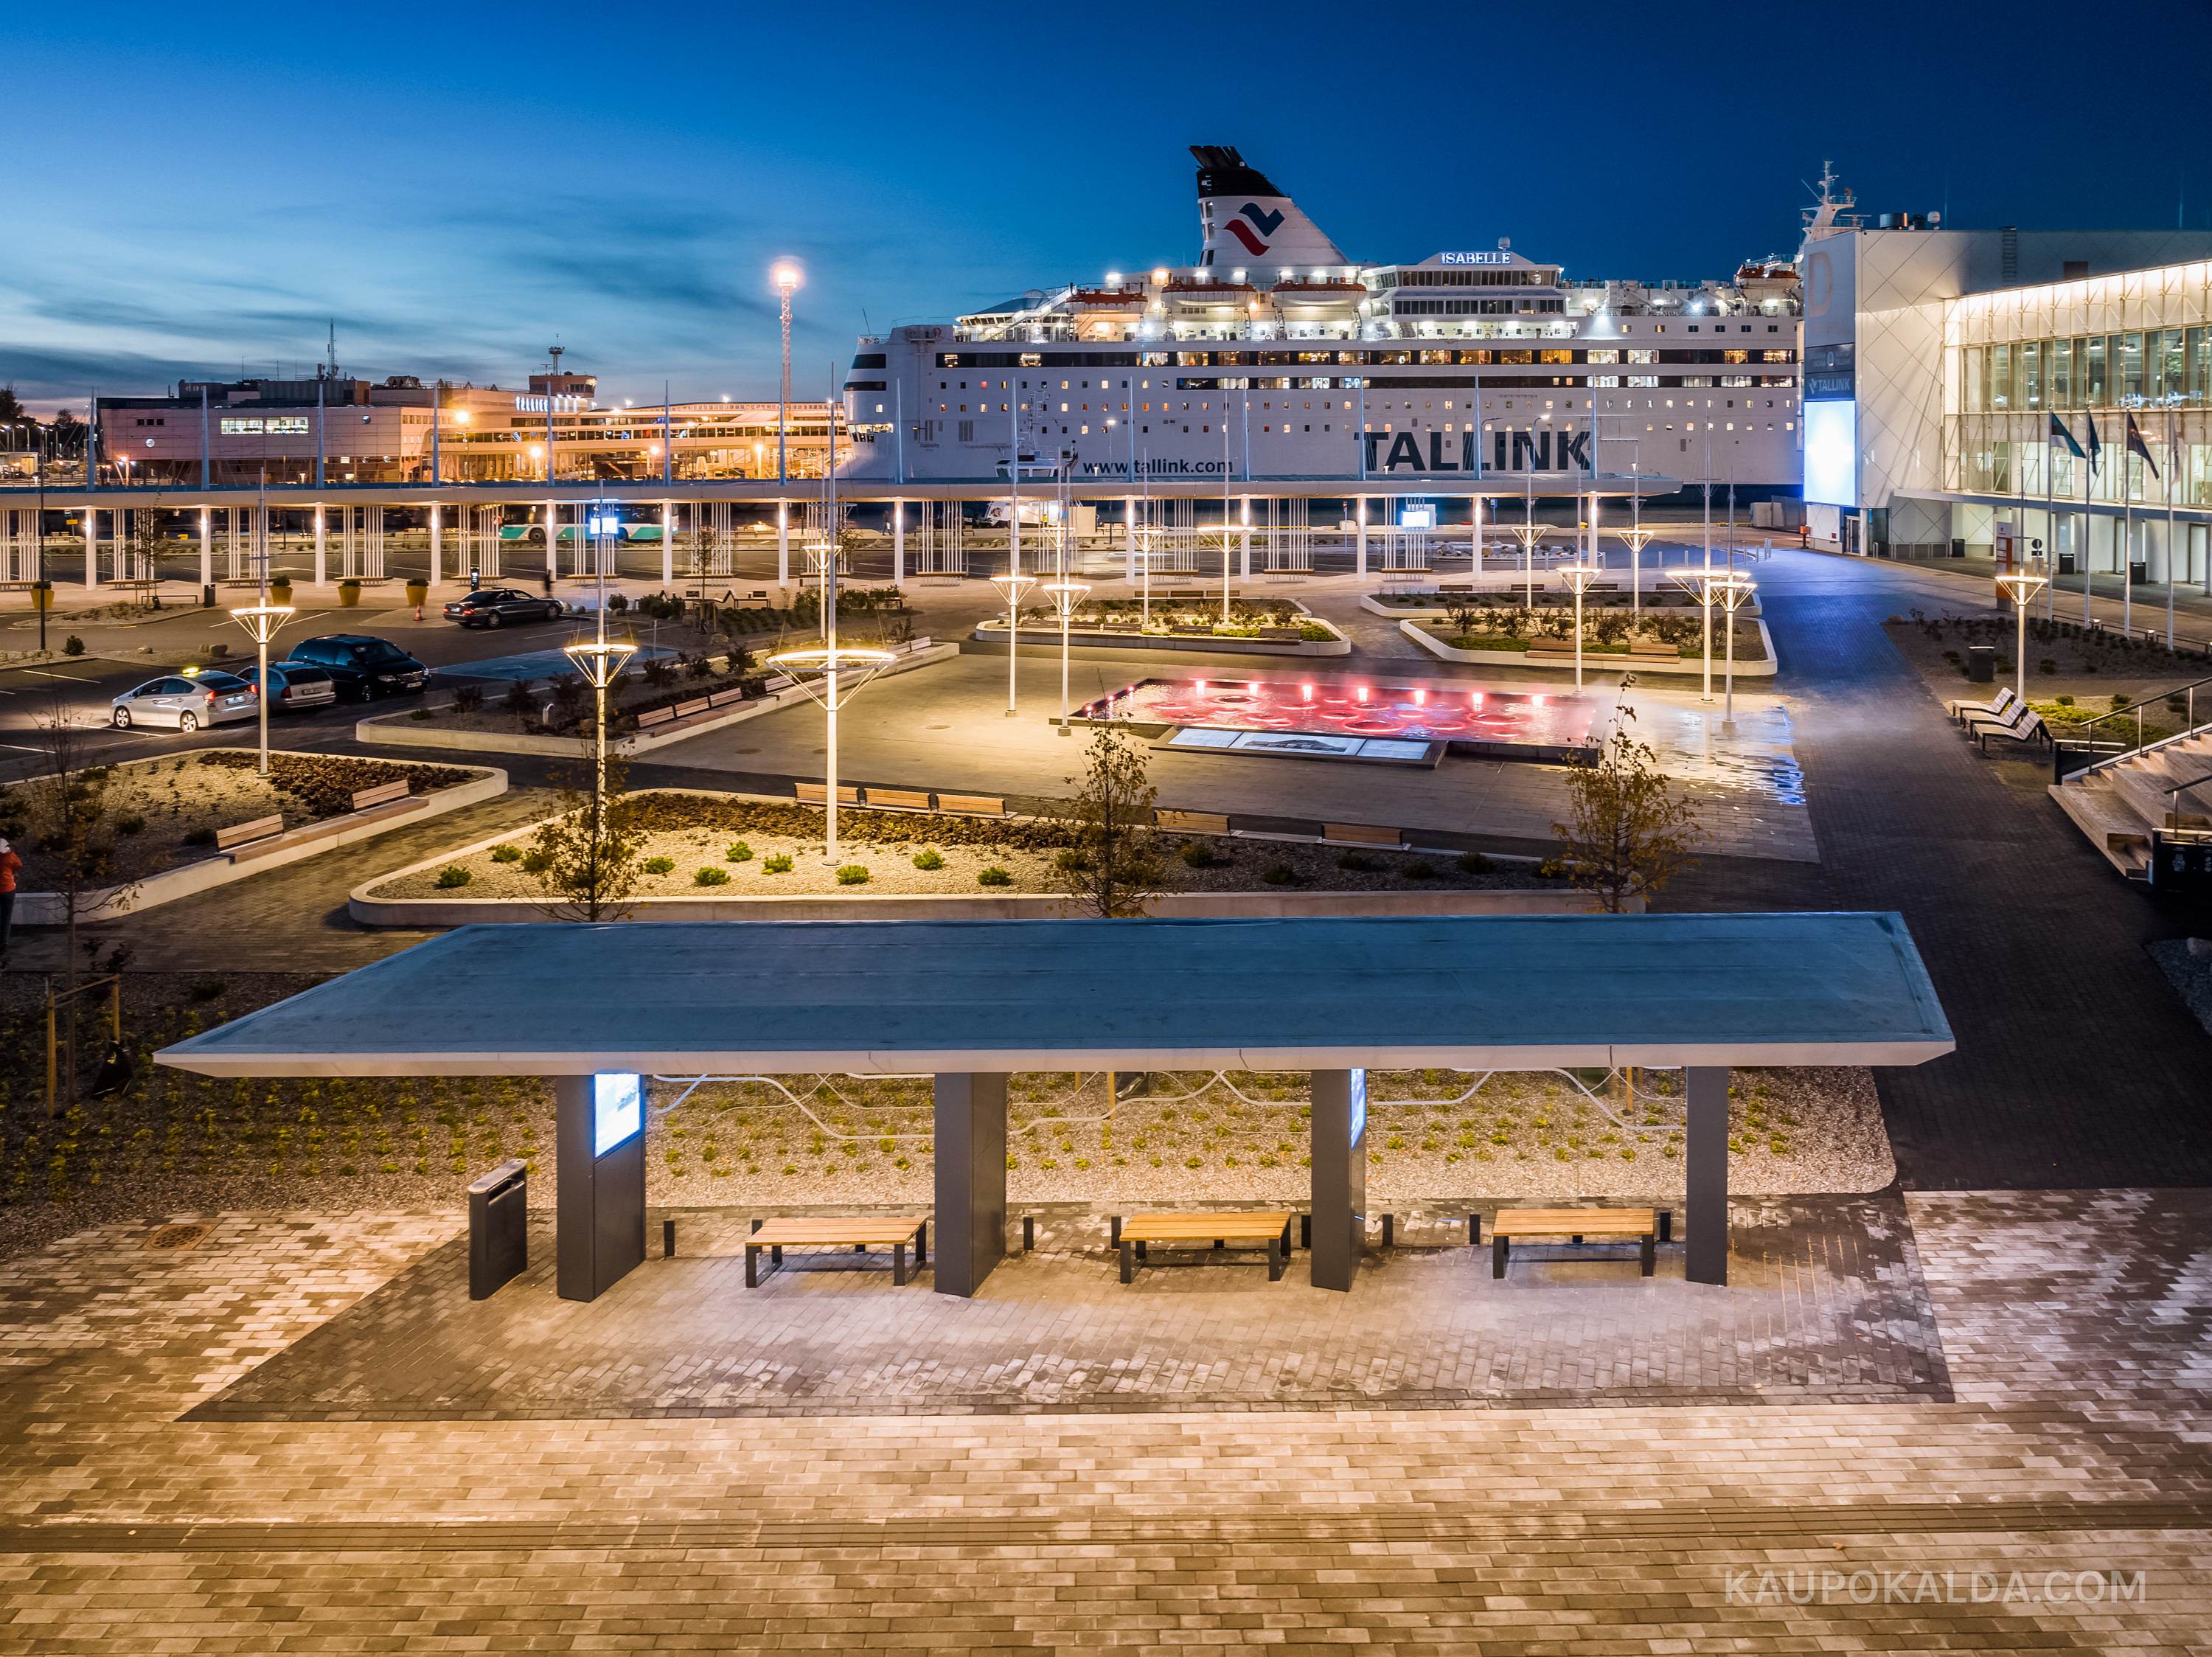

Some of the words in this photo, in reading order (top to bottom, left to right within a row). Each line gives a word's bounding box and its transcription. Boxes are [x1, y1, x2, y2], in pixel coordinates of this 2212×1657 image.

[1441, 252, 1511, 264] ISABELLE
[1809, 251, 1833, 317] D
[1818, 378, 1851, 392] TALLINK
[1354, 431, 1592, 471] TALLINK
[1083, 458, 1233, 473] wwwtallink.com
